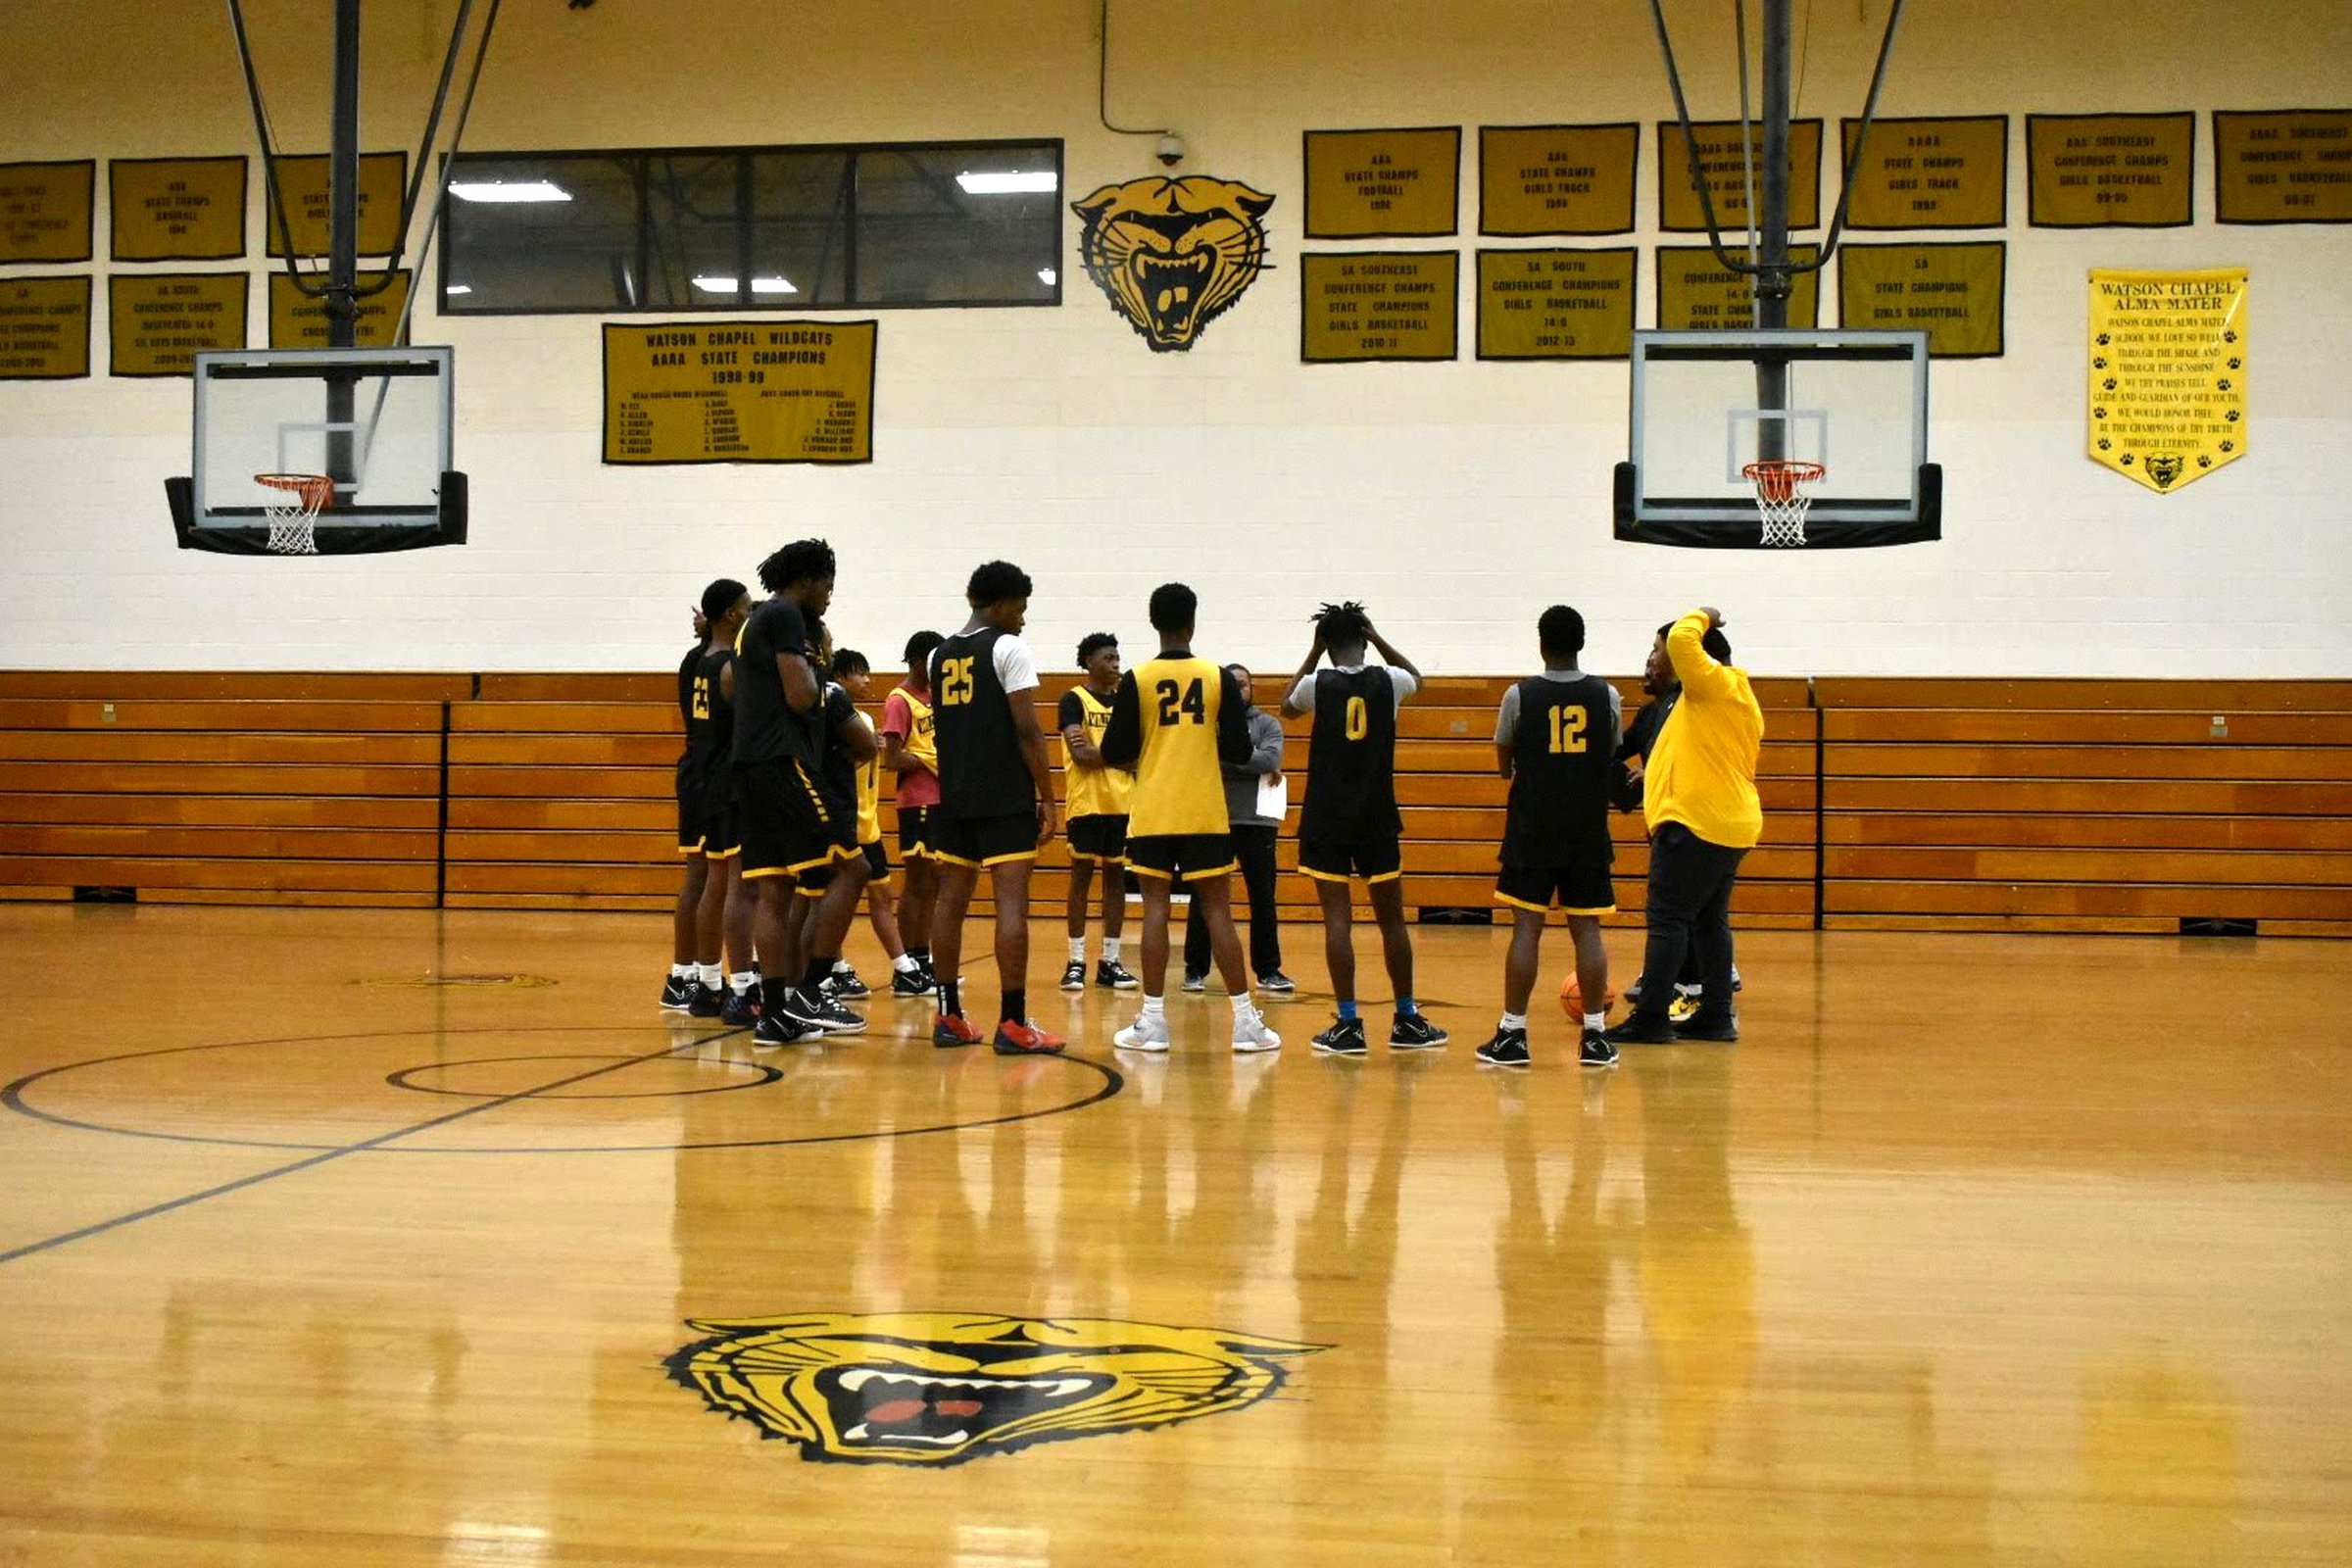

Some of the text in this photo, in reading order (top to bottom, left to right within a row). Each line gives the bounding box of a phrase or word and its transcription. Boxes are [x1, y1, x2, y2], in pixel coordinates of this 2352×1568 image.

[2096, 136, 2155, 147] SOUTHEAST
[2055, 155, 2169, 167] CONFERENCE CHAMPS
[2240, 150, 2301, 162] CONFERENCE
[1884, 158, 1964, 169] STATE CHAMPS
[1344, 170, 1419, 182] STATE CHAMPS
[1520, 167, 1595, 180] STATE CHAMPS
[1888, 178, 1959, 190] GIRLS TRACK
[2060, 174, 2163, 186] GIRLS BASKETBALL
[1358, 186, 1403, 196] FOOTBALL
[1558, 183, 1591, 193] TRACK
[1361, 265, 1417, 275] SOUTHEAST
[1552, 262, 1586, 271] SOUTH
[1914, 258, 1929, 270] 5A
[1684, 273, 1744, 284] CONFERENCE
[1325, 282, 1436, 294] CONFERENCE CHAMPS
[1492, 279, 1620, 291] CONFERENCE CHAMPIONS
[1876, 281, 1968, 293] STATE CHAMPIONS
[2101, 281, 2235, 296] WATSON CHAPEL
[1329, 301, 1430, 313] STATE CHAMPIONS
[1504, 298, 1608, 310] GIRLS BASKETBALL
[2114, 297, 2222, 311] ALMA MATER
[1690, 306, 1719, 317] STATE
[1874, 307, 1969, 318] GIRLS BASKETBALL
[1329, 319, 1429, 331] GIRLS BASKETBALL
[646, 331, 833, 347] WATSON CHAPEL WILDCATS
[2156, 348, 2171, 358] THE
[651, 351, 826, 368] AAAA STATE CHAMPIONS
[2158, 363, 2173, 372] THE
[2120, 392, 2136, 403] AND
[941, 656, 974, 707] 25
[1154, 676, 1205, 725] 24
[1344, 696, 1367, 741] 0
[1547, 704, 1588, 754] 12
